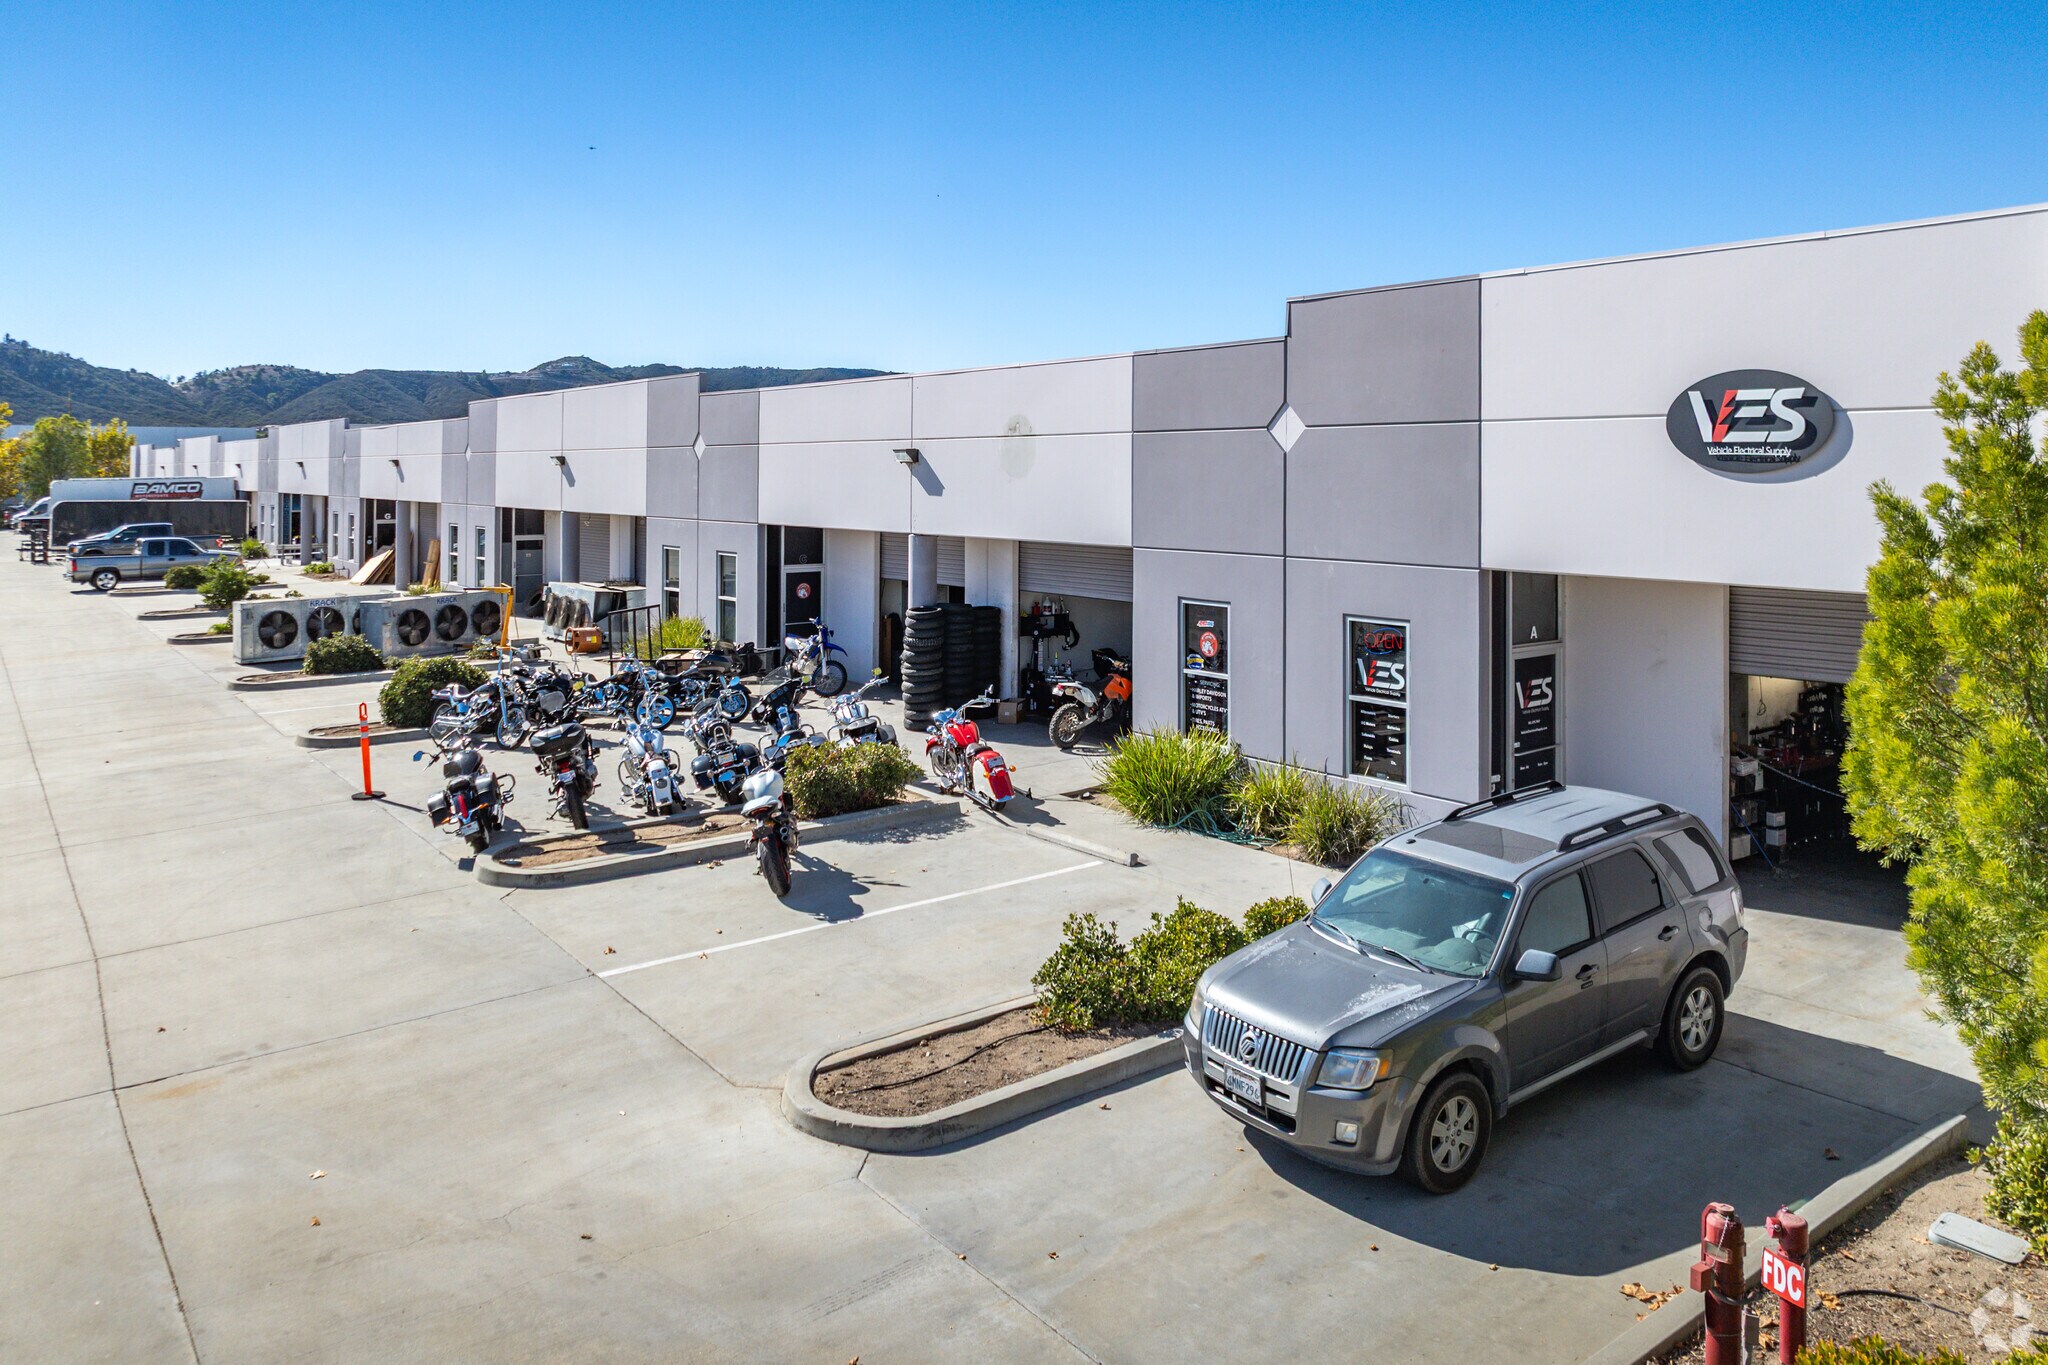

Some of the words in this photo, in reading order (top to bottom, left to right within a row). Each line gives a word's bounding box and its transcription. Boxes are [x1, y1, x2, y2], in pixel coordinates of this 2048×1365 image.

[1687, 387, 1806, 443] VES
[1707, 446, 1732, 456] Vehicle
[1733, 446, 1764, 456] Electrical
[1765, 446, 1792, 457] Supply
[133, 483, 201, 494] BAMCO
[384, 512, 392, 520] G
[799, 553, 808, 564] C
[309, 598, 337, 607] KRACK
[436, 596, 458, 605] KRACK
[1530, 625, 1538, 639] A
[1363, 632, 1403, 650] OPEN
[1356, 657, 1405, 690] VES
[1515, 676, 1553, 709] VES
[1763, 1250, 1802, 1302] FDC
